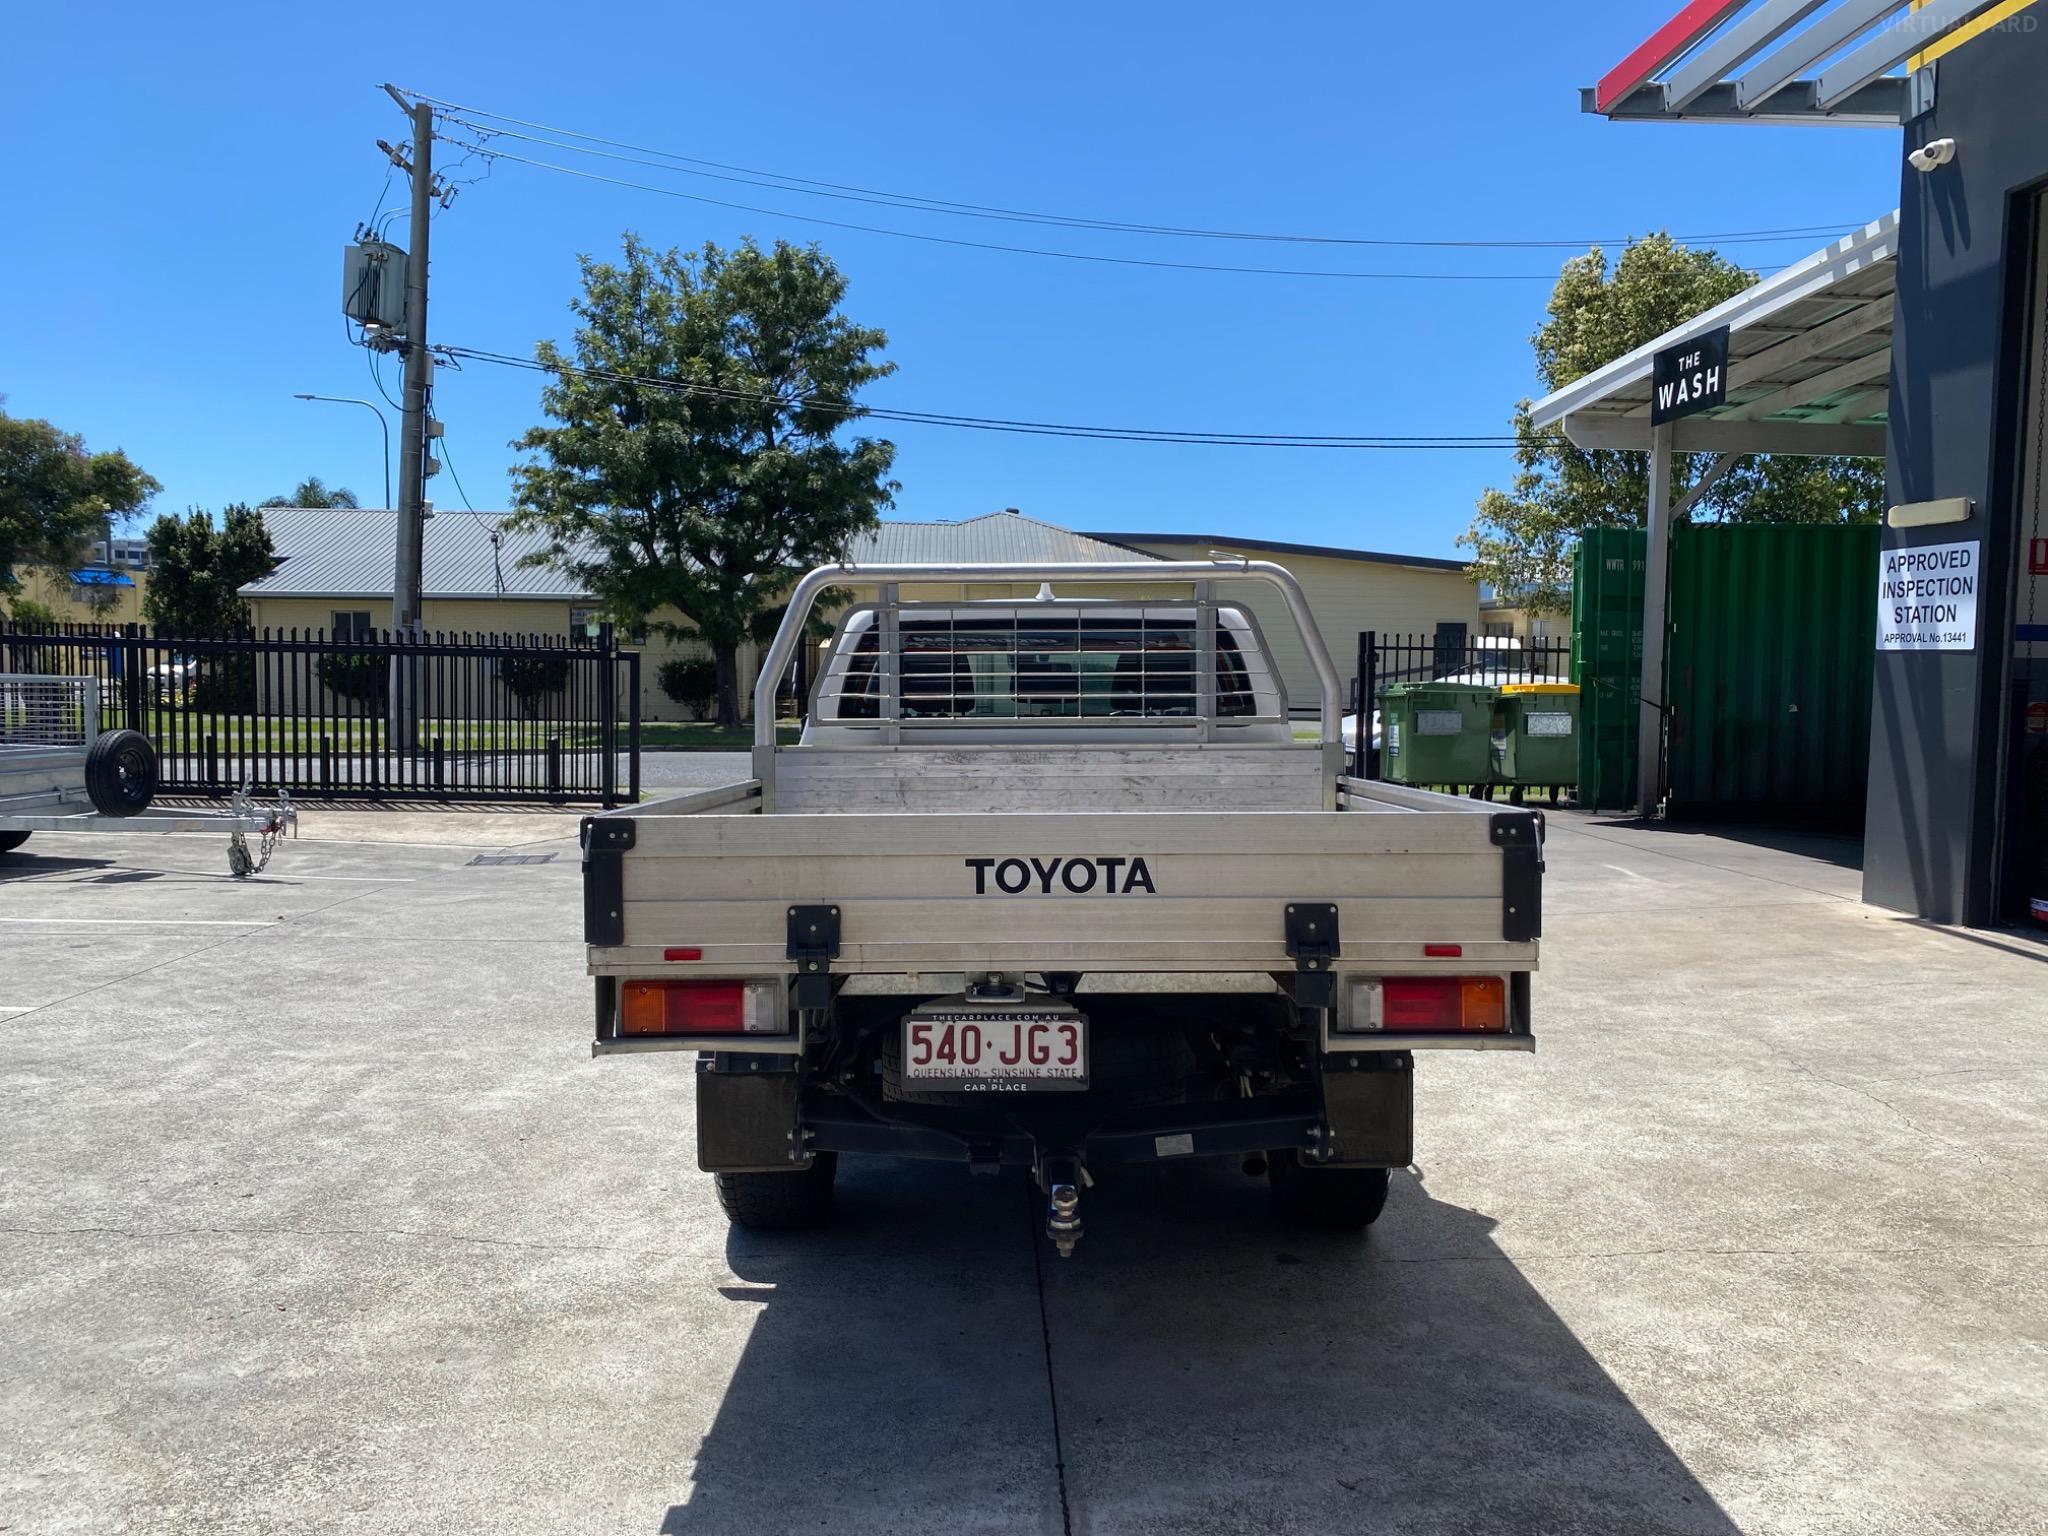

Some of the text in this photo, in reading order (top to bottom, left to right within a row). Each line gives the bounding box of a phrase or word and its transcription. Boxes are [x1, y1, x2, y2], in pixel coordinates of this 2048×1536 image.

[1679, 351, 1701, 372] THE
[1659, 366, 1719, 410] WASH
[1887, 550, 1970, 573] APPROVED
[1883, 576, 1973, 599] INSPECTION
[1894, 604, 1957, 624] STATION
[1884, 633, 1927, 643] APPROVAL
[965, 857, 1156, 895] TOYOTA
[913, 1068, 981, 1078] QUEENSLAND
[991, 1068, 1041, 1078] SUNSHINE
[1047, 1068, 1077, 1078] STATE
[964, 1084, 1027, 1092] CAR PLACE
